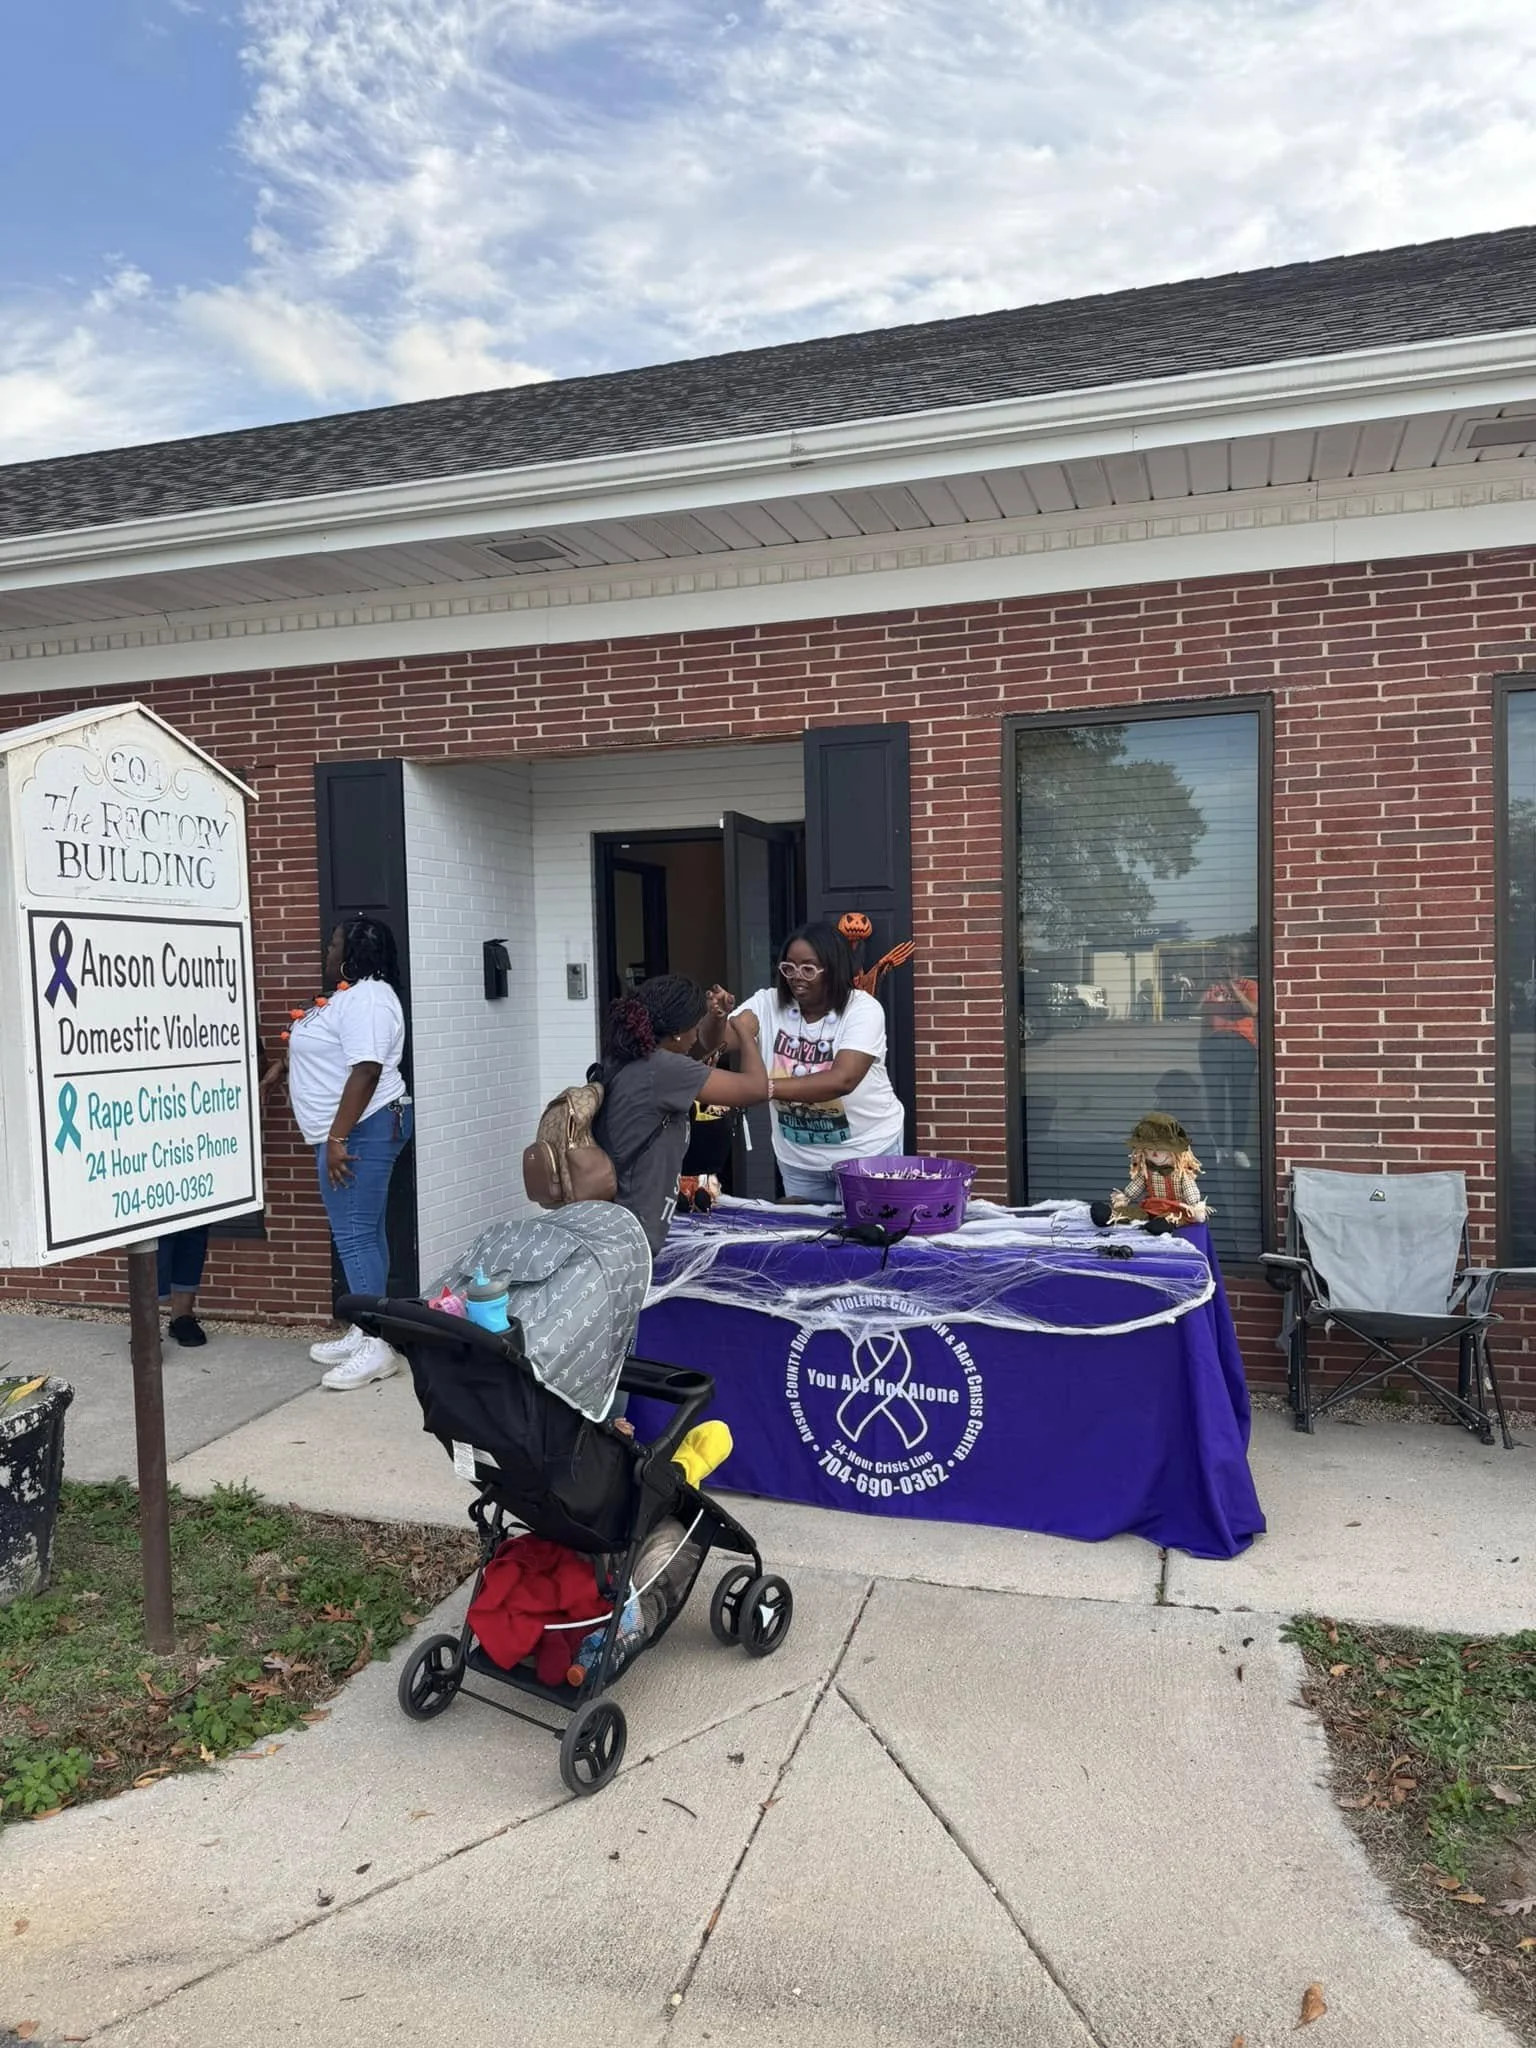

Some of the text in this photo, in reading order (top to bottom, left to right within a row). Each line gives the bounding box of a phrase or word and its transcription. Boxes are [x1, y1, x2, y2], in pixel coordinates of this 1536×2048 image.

[42, 785, 229, 852] The RECTORY
[55, 840, 216, 889] BUILDING
[80, 938, 237, 1004] Anson County
[58, 1014, 241, 1055] Domestic Violence
[88, 1078, 241, 1141] Rape Crisis Center
[86, 1133, 238, 1182] 24 Hour Crisis Phone
[112, 1173, 214, 1218] 704-690-0362
[944, 1334, 956, 1346] &
[952, 1342, 977, 1375] RAPE
[785, 1351, 801, 1399] COUNTY
[807, 1368, 959, 1404] You Are Not Alone
[966, 1374, 983, 1417] CRISIS
[790, 1401, 815, 1443] ANSON
[953, 1419, 983, 1461] CENTER
[818, 1450, 949, 1497] 704-690-0362
[831, 1439, 934, 1474] 24-Hour Crisis Line
